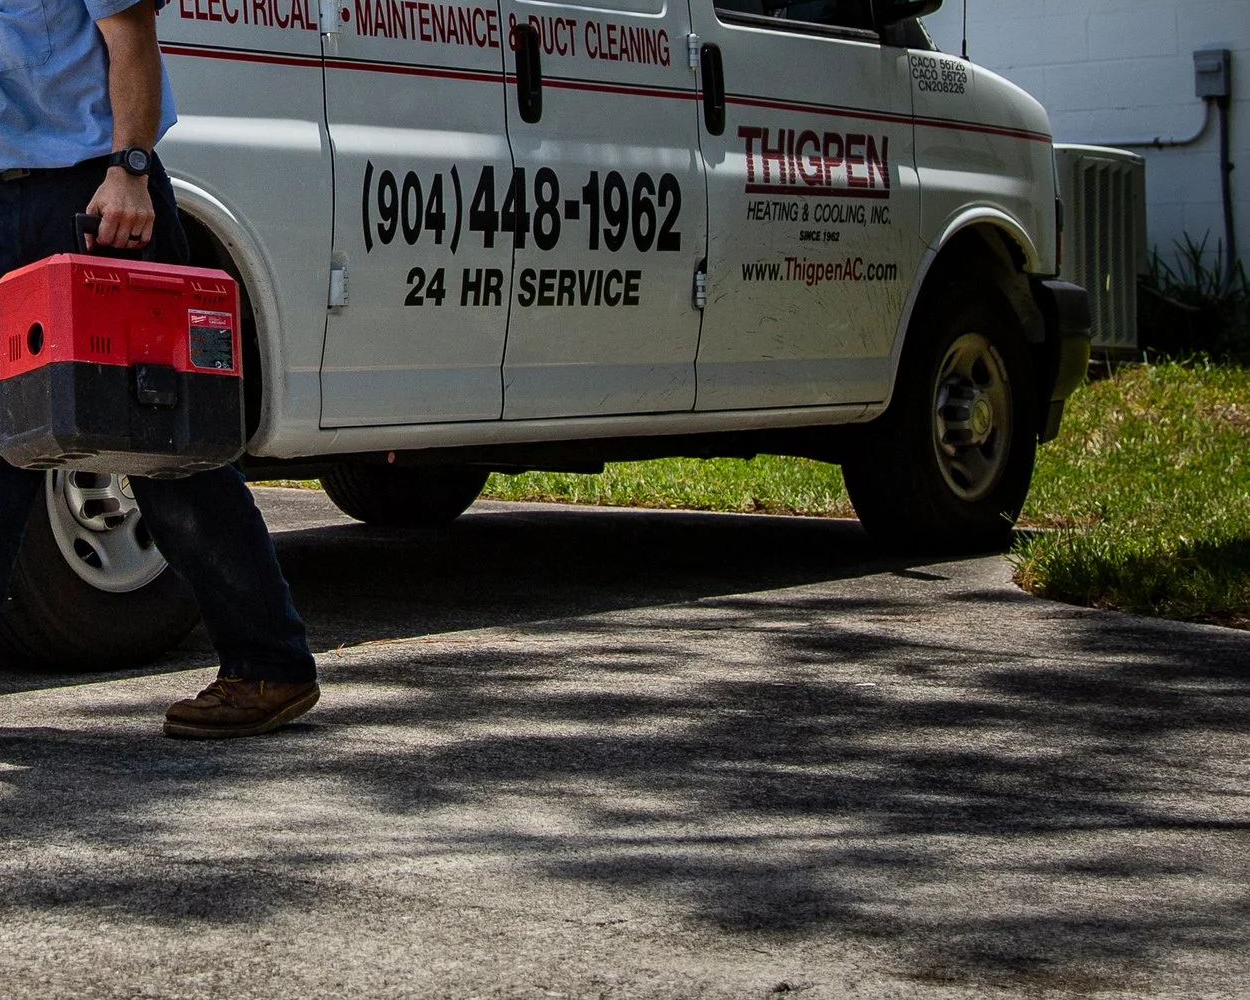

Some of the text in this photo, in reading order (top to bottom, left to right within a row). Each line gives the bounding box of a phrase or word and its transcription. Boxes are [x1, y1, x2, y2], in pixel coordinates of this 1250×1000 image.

[528, 15, 577, 57] DUCT
[584, 20, 671, 68] CLEANING
[910, 56, 937, 68] CACO
[912, 68, 967, 83] CACO 56729
[737, 126, 890, 189] THIGPEN
[747, 201, 892, 227] HEATING & COOLING, INC.
[799, 230, 840, 242] SINCE 1962
[742, 256, 897, 286] www.ThigpenAC.com
[403, 266, 643, 307] 24 HR SERVICE
